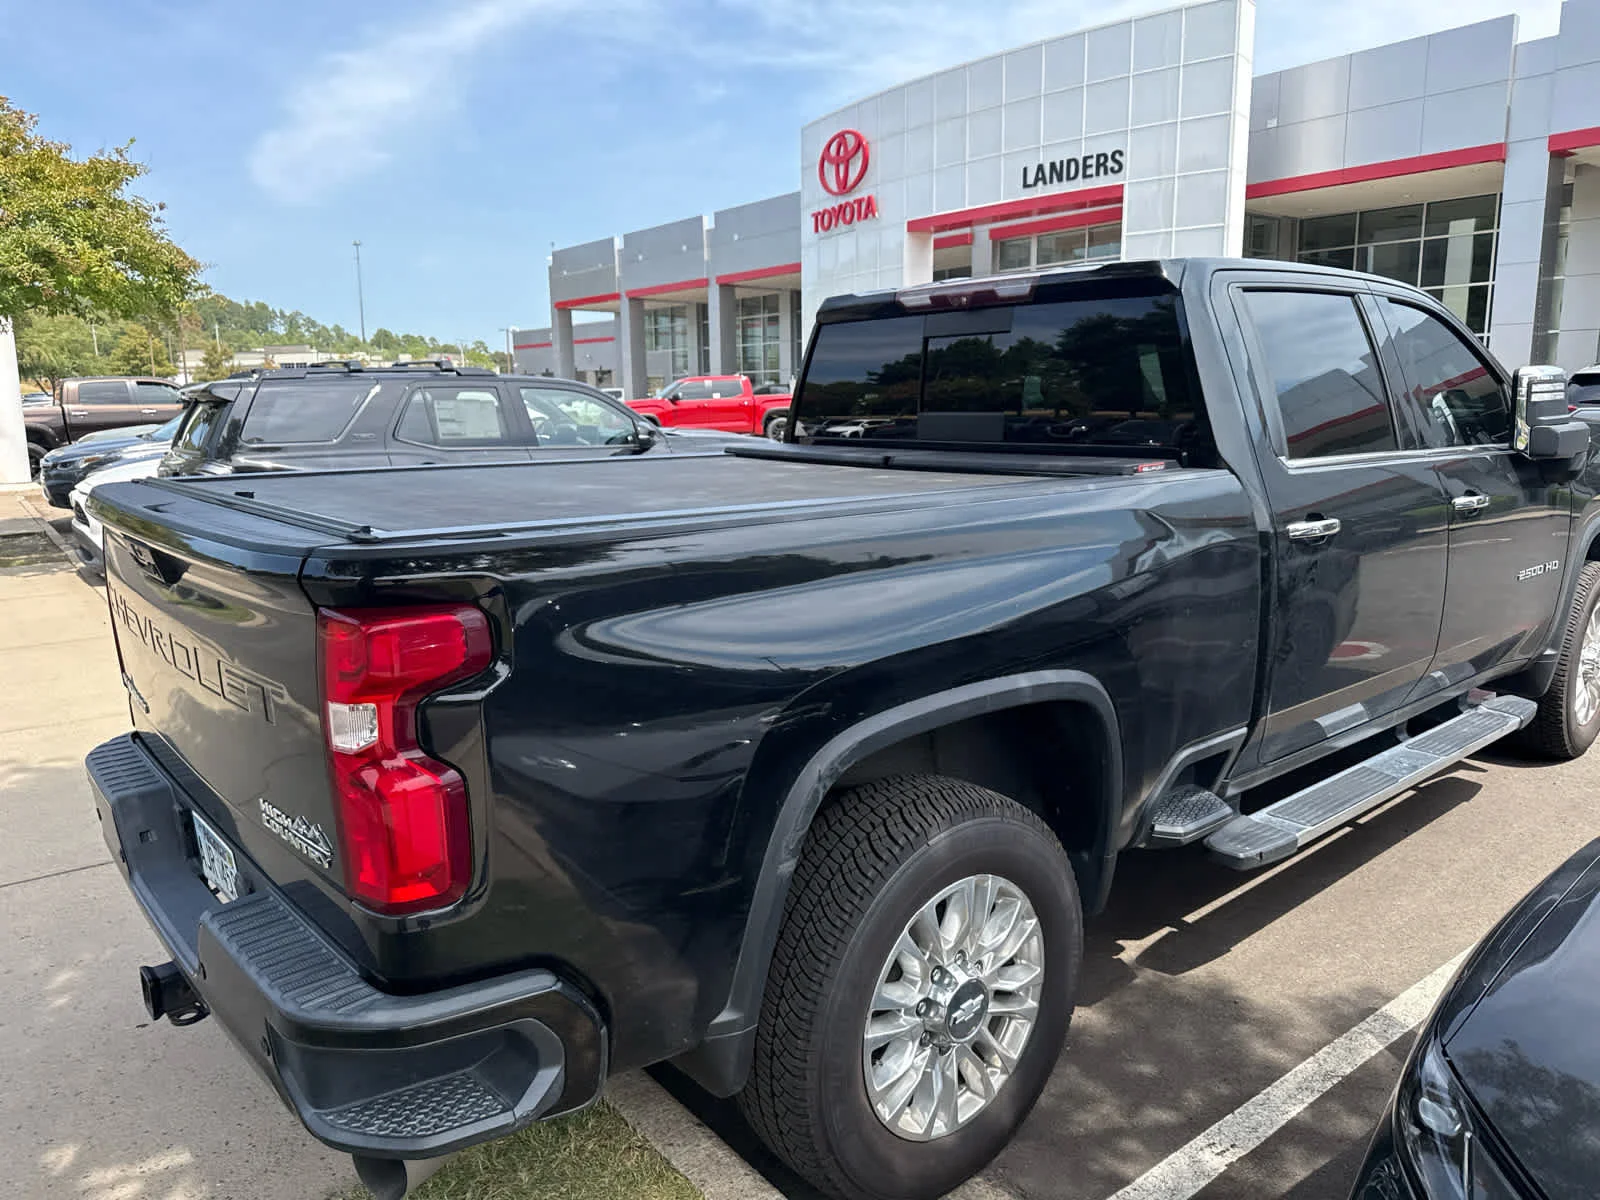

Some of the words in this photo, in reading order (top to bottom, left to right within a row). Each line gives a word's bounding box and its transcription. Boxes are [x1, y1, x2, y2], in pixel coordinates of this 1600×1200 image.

[1022, 149, 1124, 189] LANDERS
[811, 195, 877, 233] TOYOTA
[1517, 564, 1544, 581] 2500
[1545, 560, 1560, 573] HD
